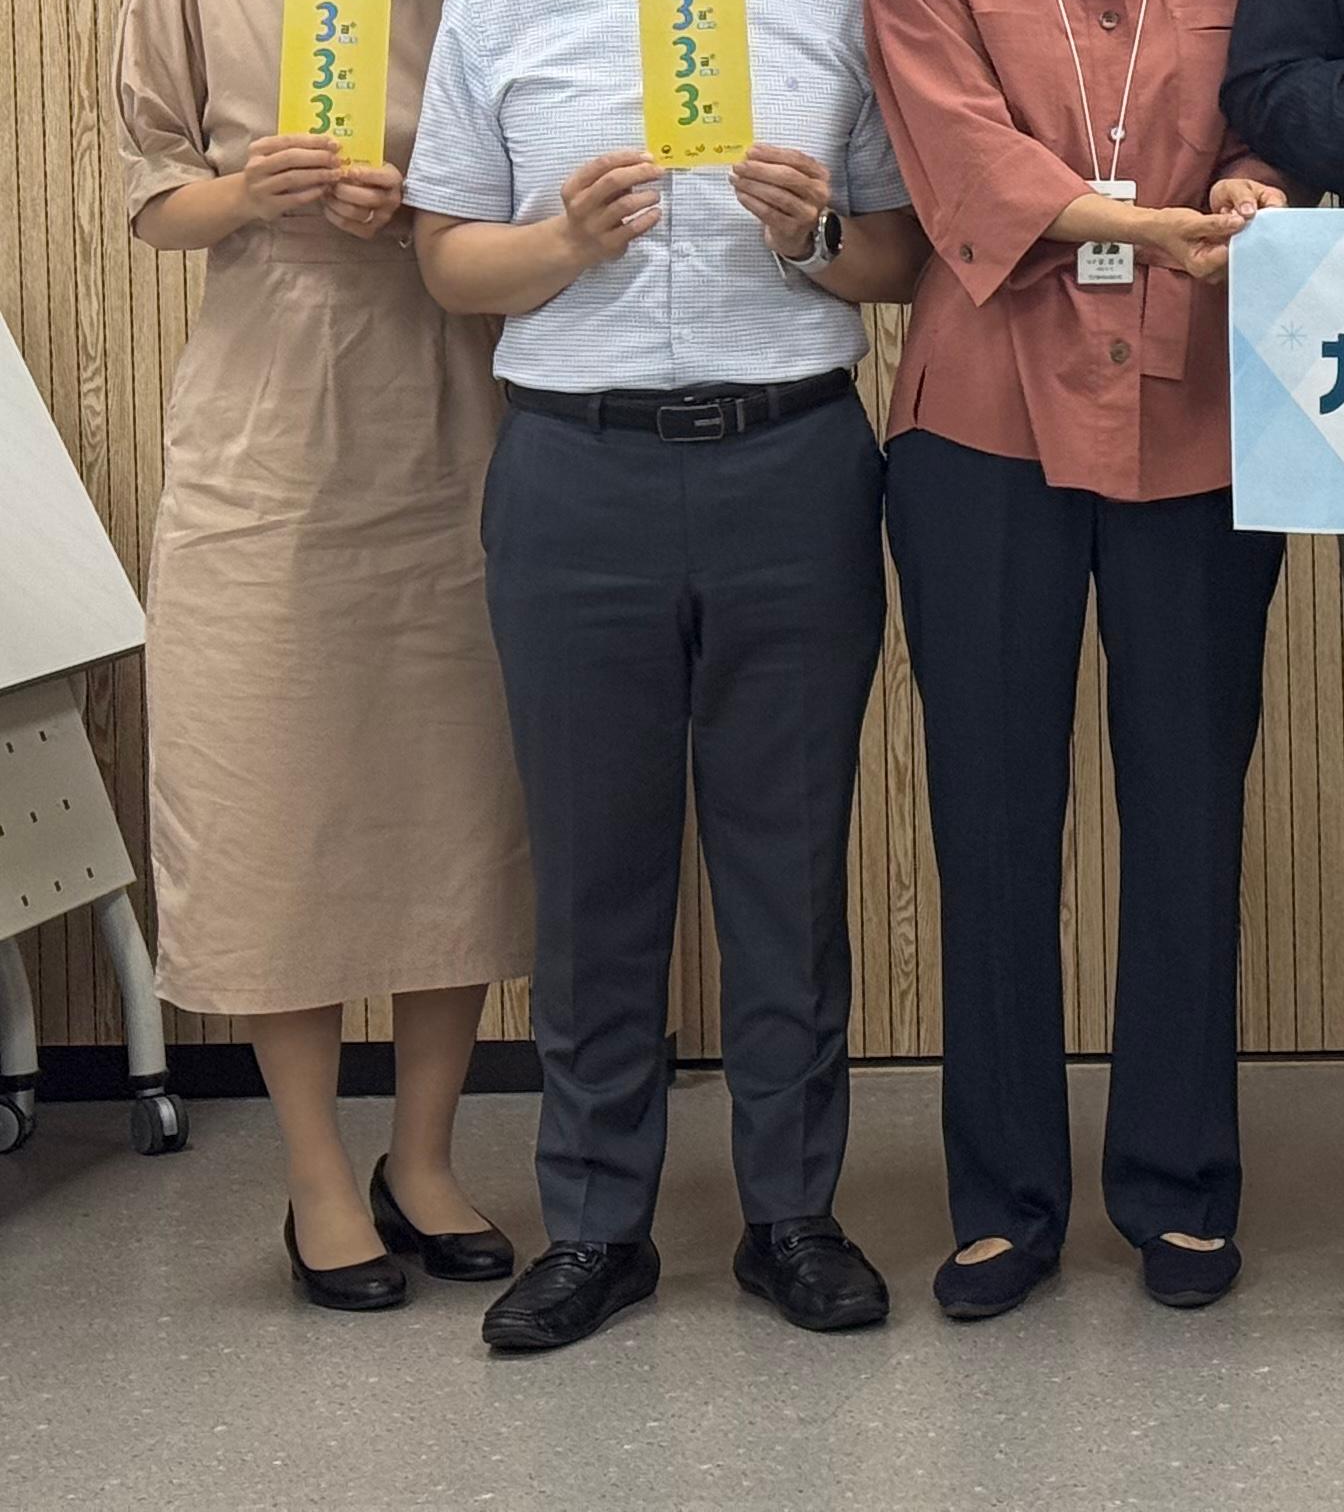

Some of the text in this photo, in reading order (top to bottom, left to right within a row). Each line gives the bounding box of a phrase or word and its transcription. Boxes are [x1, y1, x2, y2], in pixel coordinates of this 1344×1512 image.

[315, 1, 339, 42] 3
[312, 48, 336, 89] 3
[672, 36, 697, 79] 3
[308, 94, 333, 134] 3
[675, 83, 699, 126] 3
